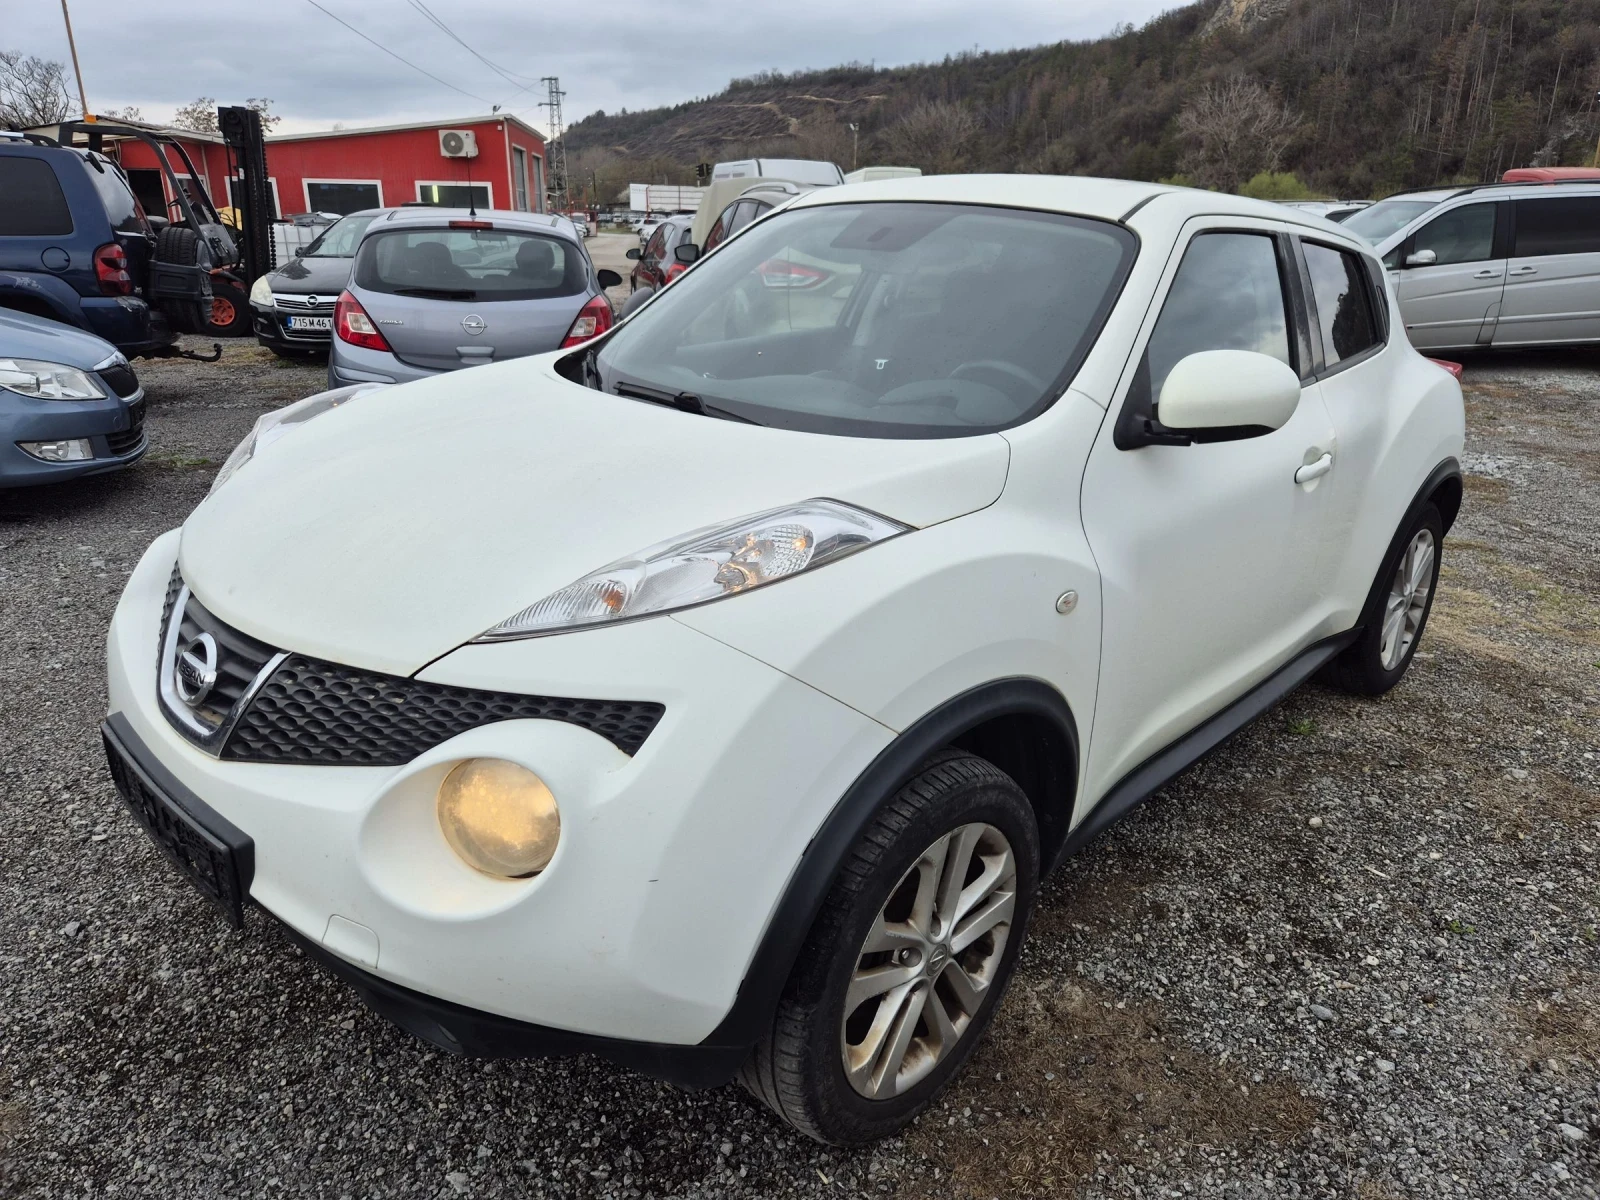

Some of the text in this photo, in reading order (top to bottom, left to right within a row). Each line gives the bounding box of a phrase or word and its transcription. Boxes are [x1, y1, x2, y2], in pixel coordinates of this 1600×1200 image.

[292, 317, 308, 327] 715
[308, 318, 315, 328] M
[180, 662, 206, 685] SSAN
